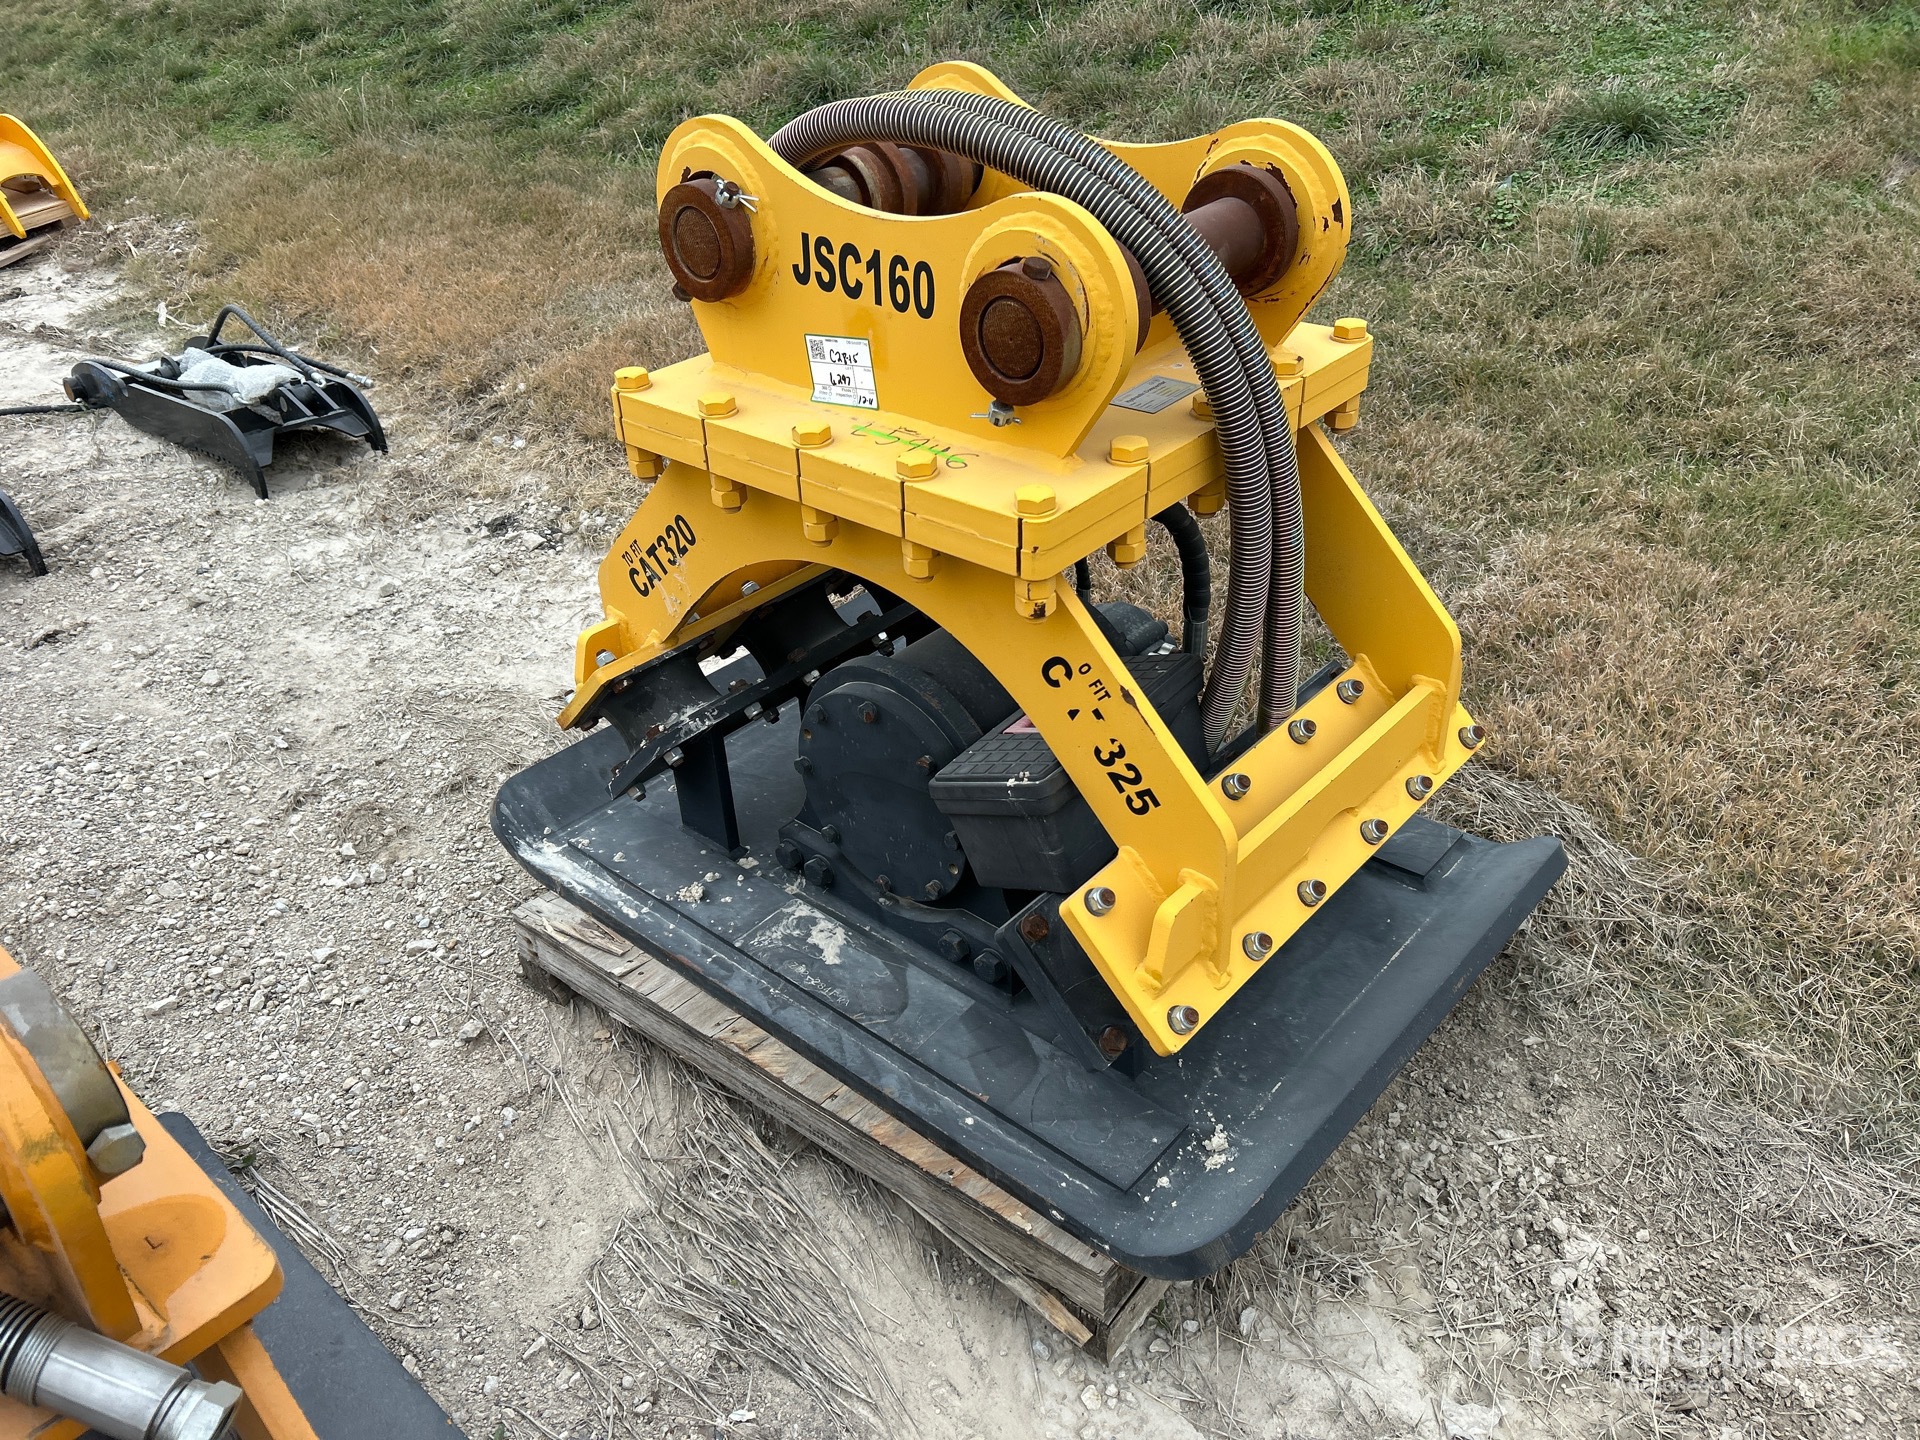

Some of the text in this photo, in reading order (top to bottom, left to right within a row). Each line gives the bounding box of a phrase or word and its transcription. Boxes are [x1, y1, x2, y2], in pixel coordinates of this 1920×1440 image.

[792, 232, 935, 319] JSC160
[621, 538, 643, 567] TO FIT
[628, 514, 697, 598] CAT320
[1078, 662, 1112, 702] O FIT
[1041, 655, 1161, 816] C325
